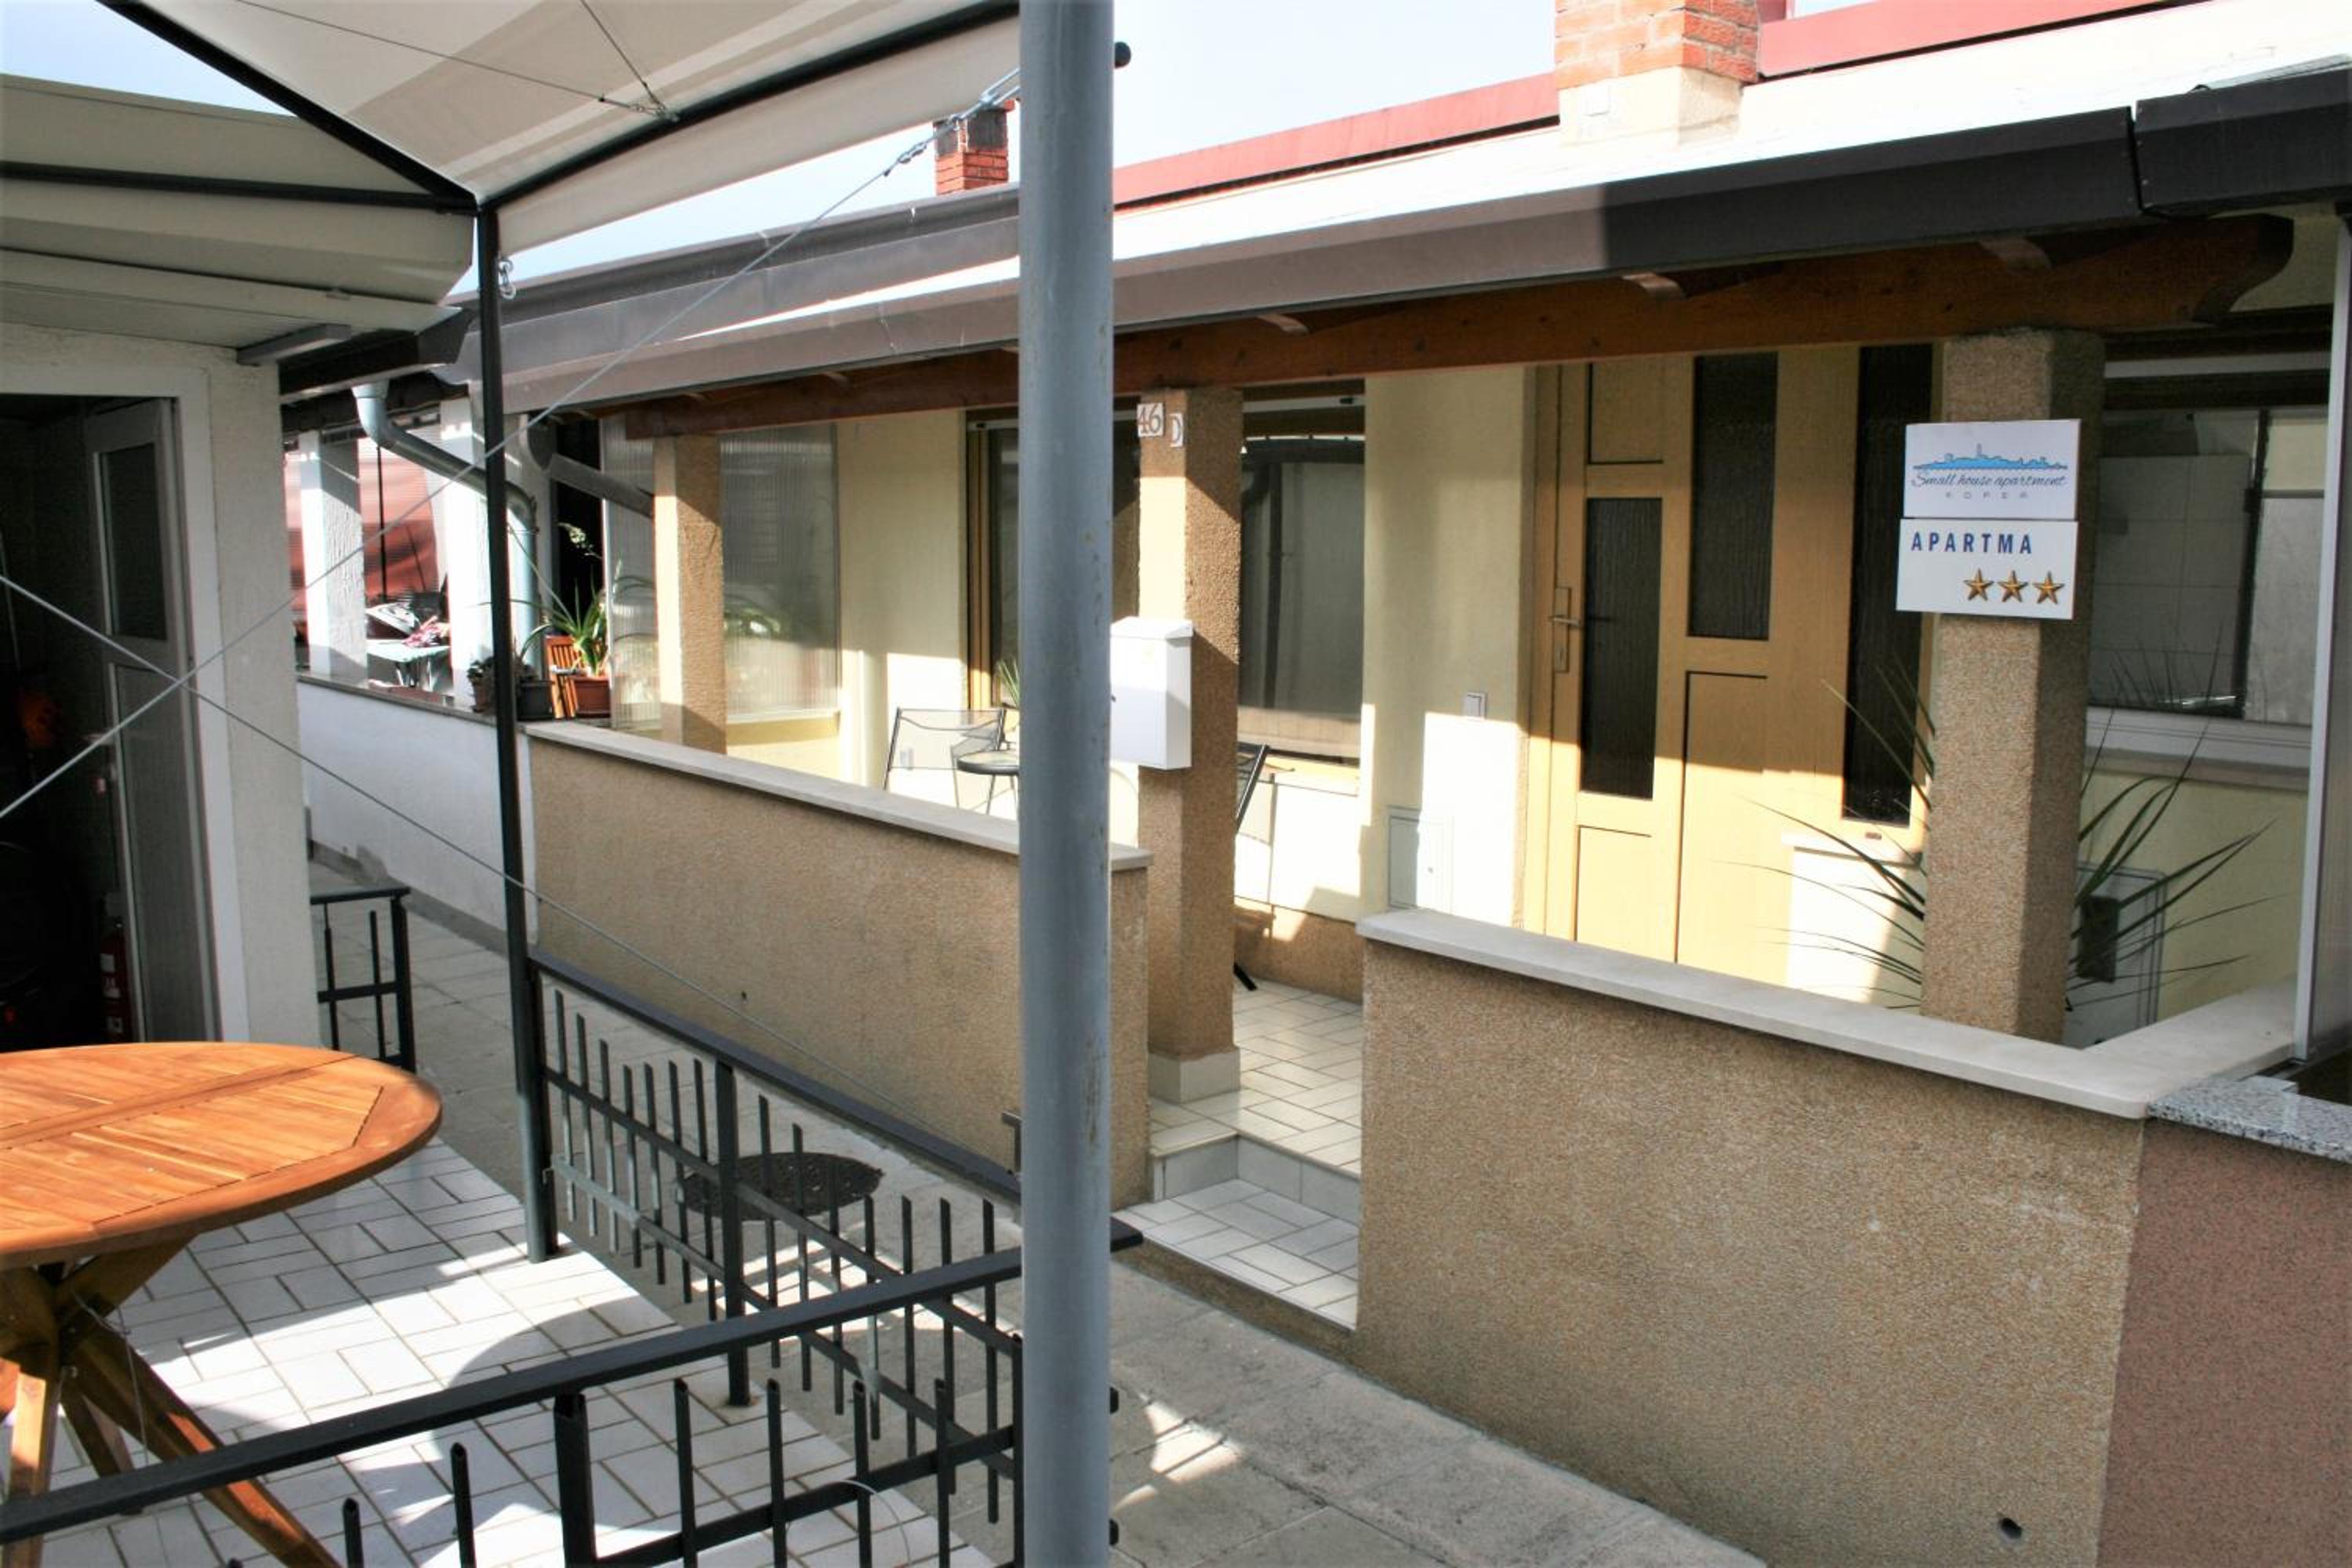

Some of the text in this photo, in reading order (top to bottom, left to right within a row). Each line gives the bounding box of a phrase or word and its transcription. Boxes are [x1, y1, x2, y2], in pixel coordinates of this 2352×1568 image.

[1138, 403, 1161, 434] 46
[1911, 473, 2066, 489] Small house apartment
[1911, 531, 2033, 554] APARTMA
